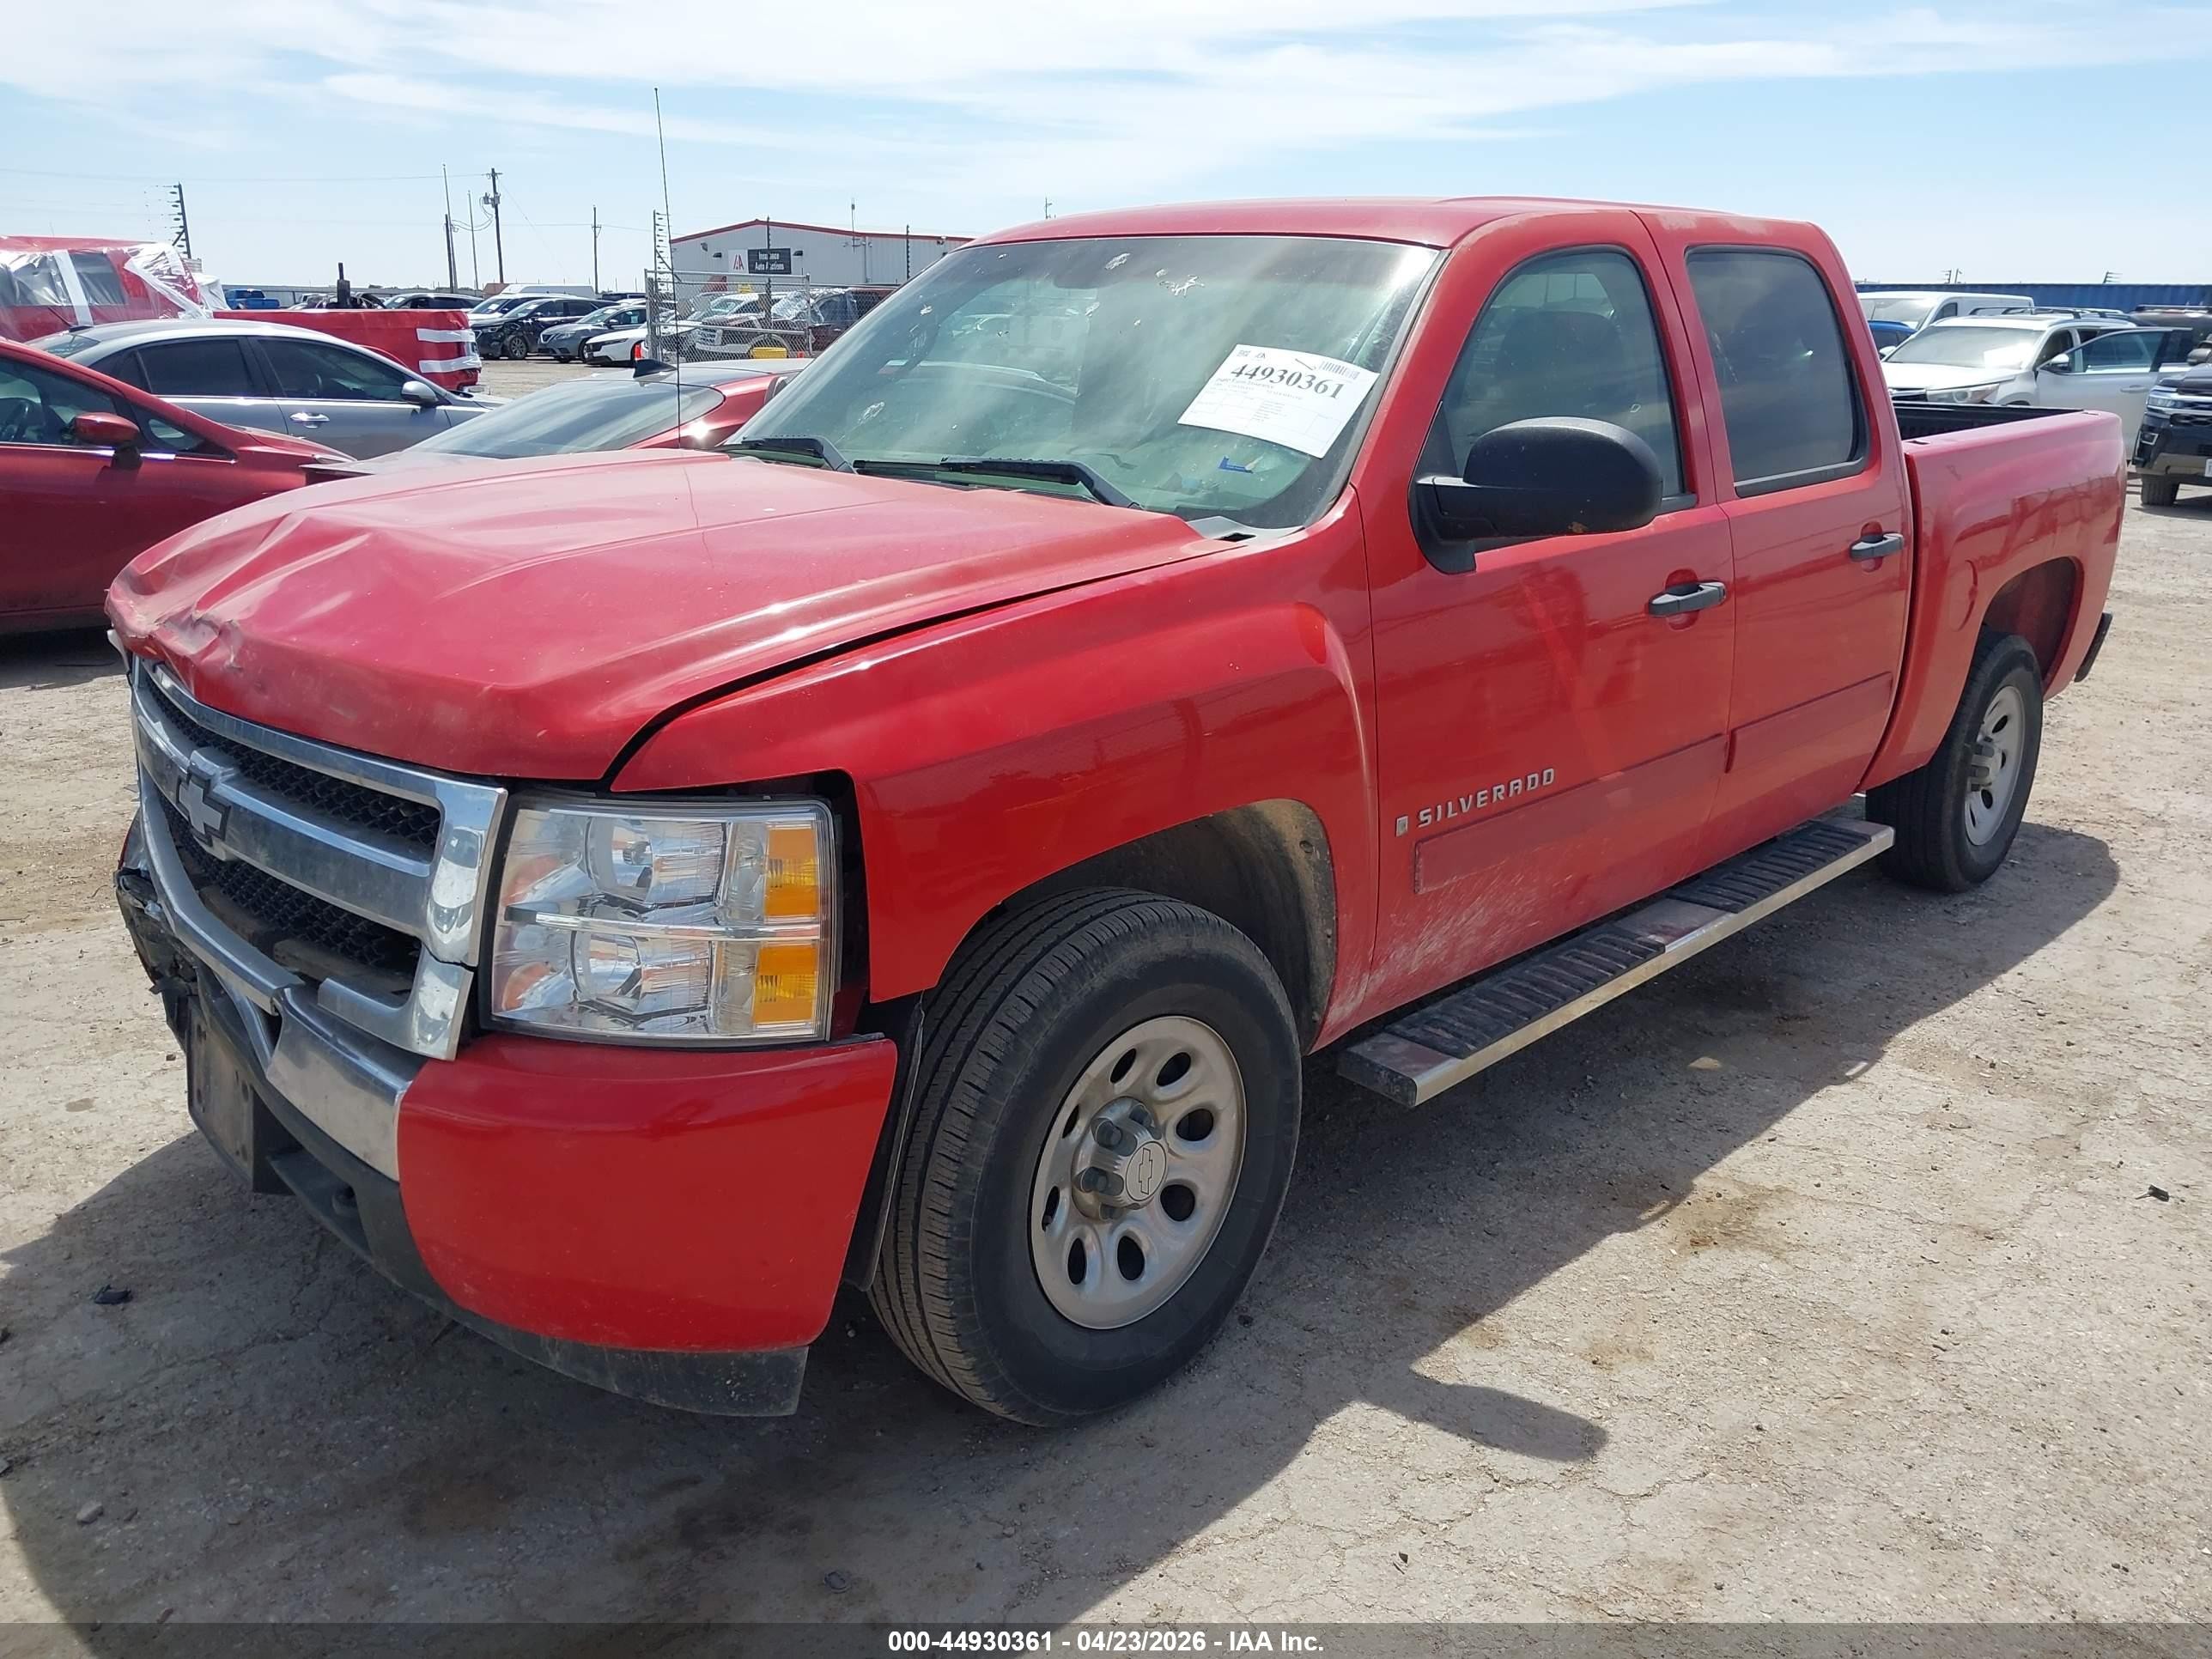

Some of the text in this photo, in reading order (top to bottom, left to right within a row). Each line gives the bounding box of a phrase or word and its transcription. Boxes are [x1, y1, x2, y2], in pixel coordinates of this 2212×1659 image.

[755, 260, 785, 270] Auto Actions
[758, 251, 780, 260] Insuance
[1230, 362, 1345, 400] 44930361
[1417, 767, 1555, 829] SILVERADO
